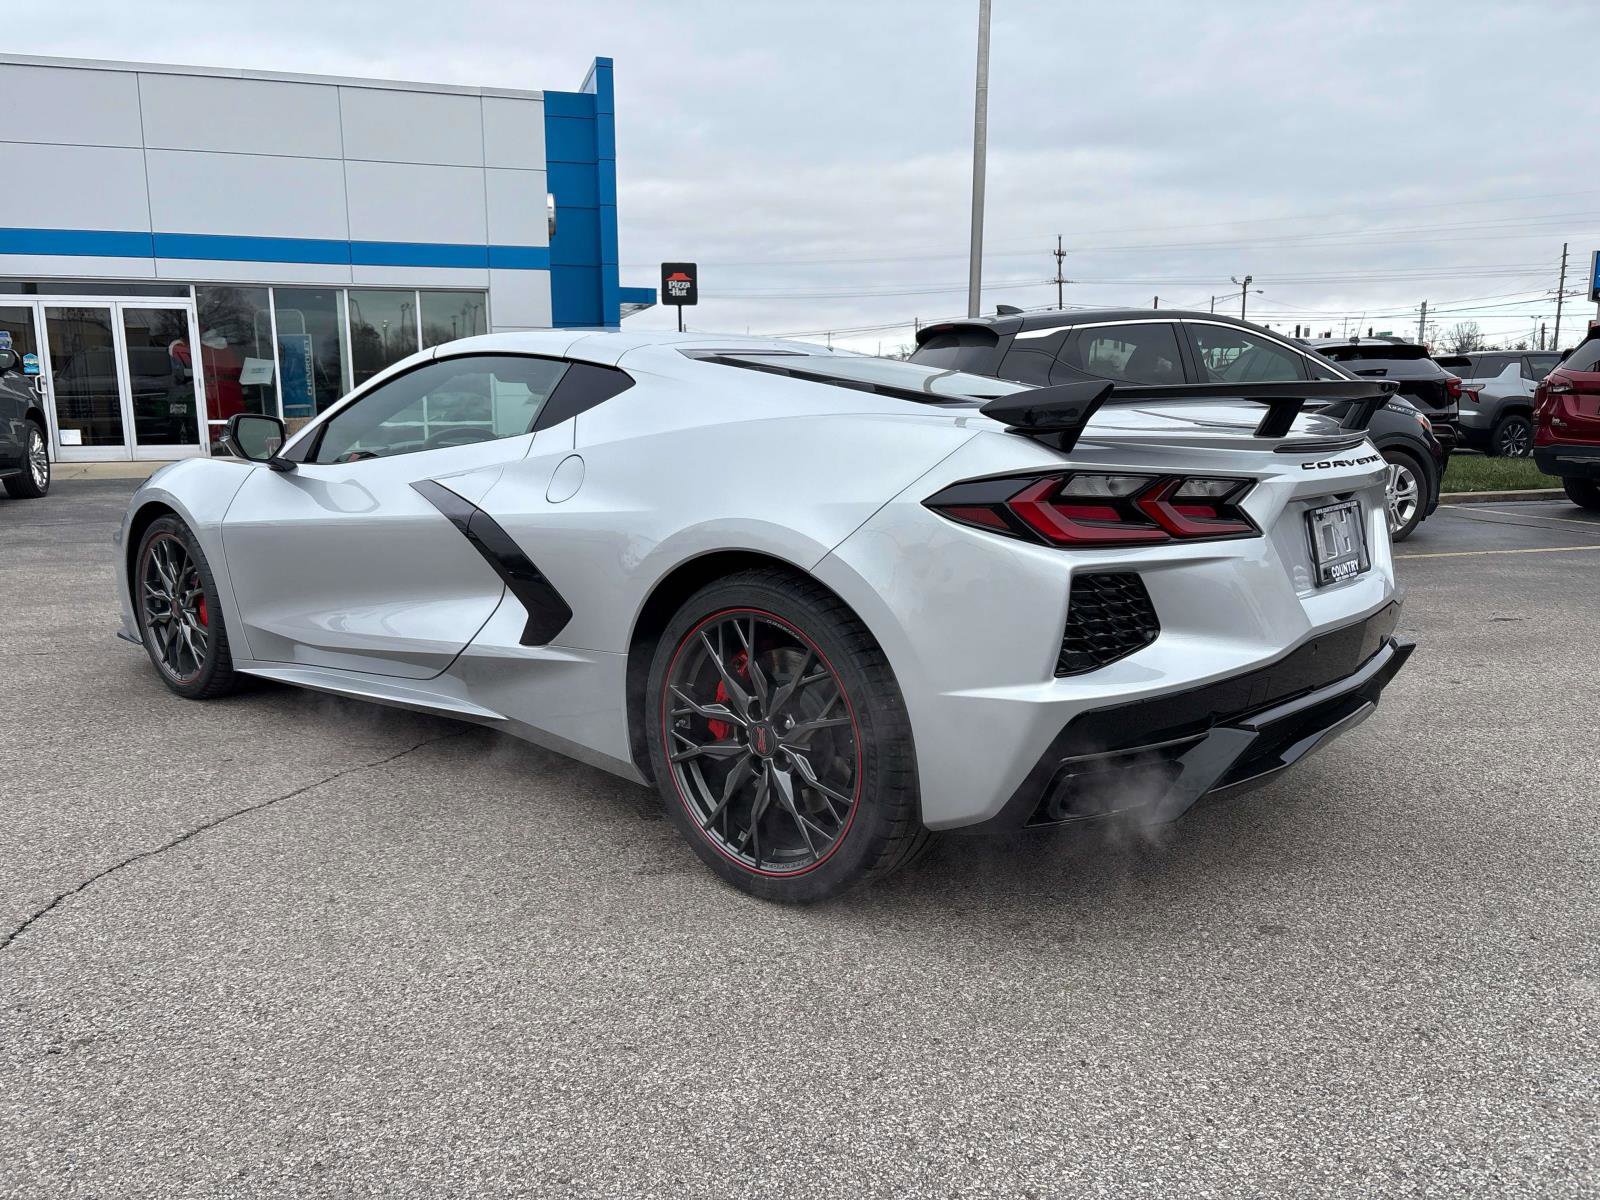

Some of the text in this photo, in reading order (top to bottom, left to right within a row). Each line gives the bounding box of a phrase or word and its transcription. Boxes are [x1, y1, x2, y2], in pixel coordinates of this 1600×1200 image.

[668, 280, 691, 289] Pizza
[669, 287, 687, 296] Hut
[1302, 454, 1380, 470] CORVETTE
[1331, 559, 1359, 577] COUNTRY
